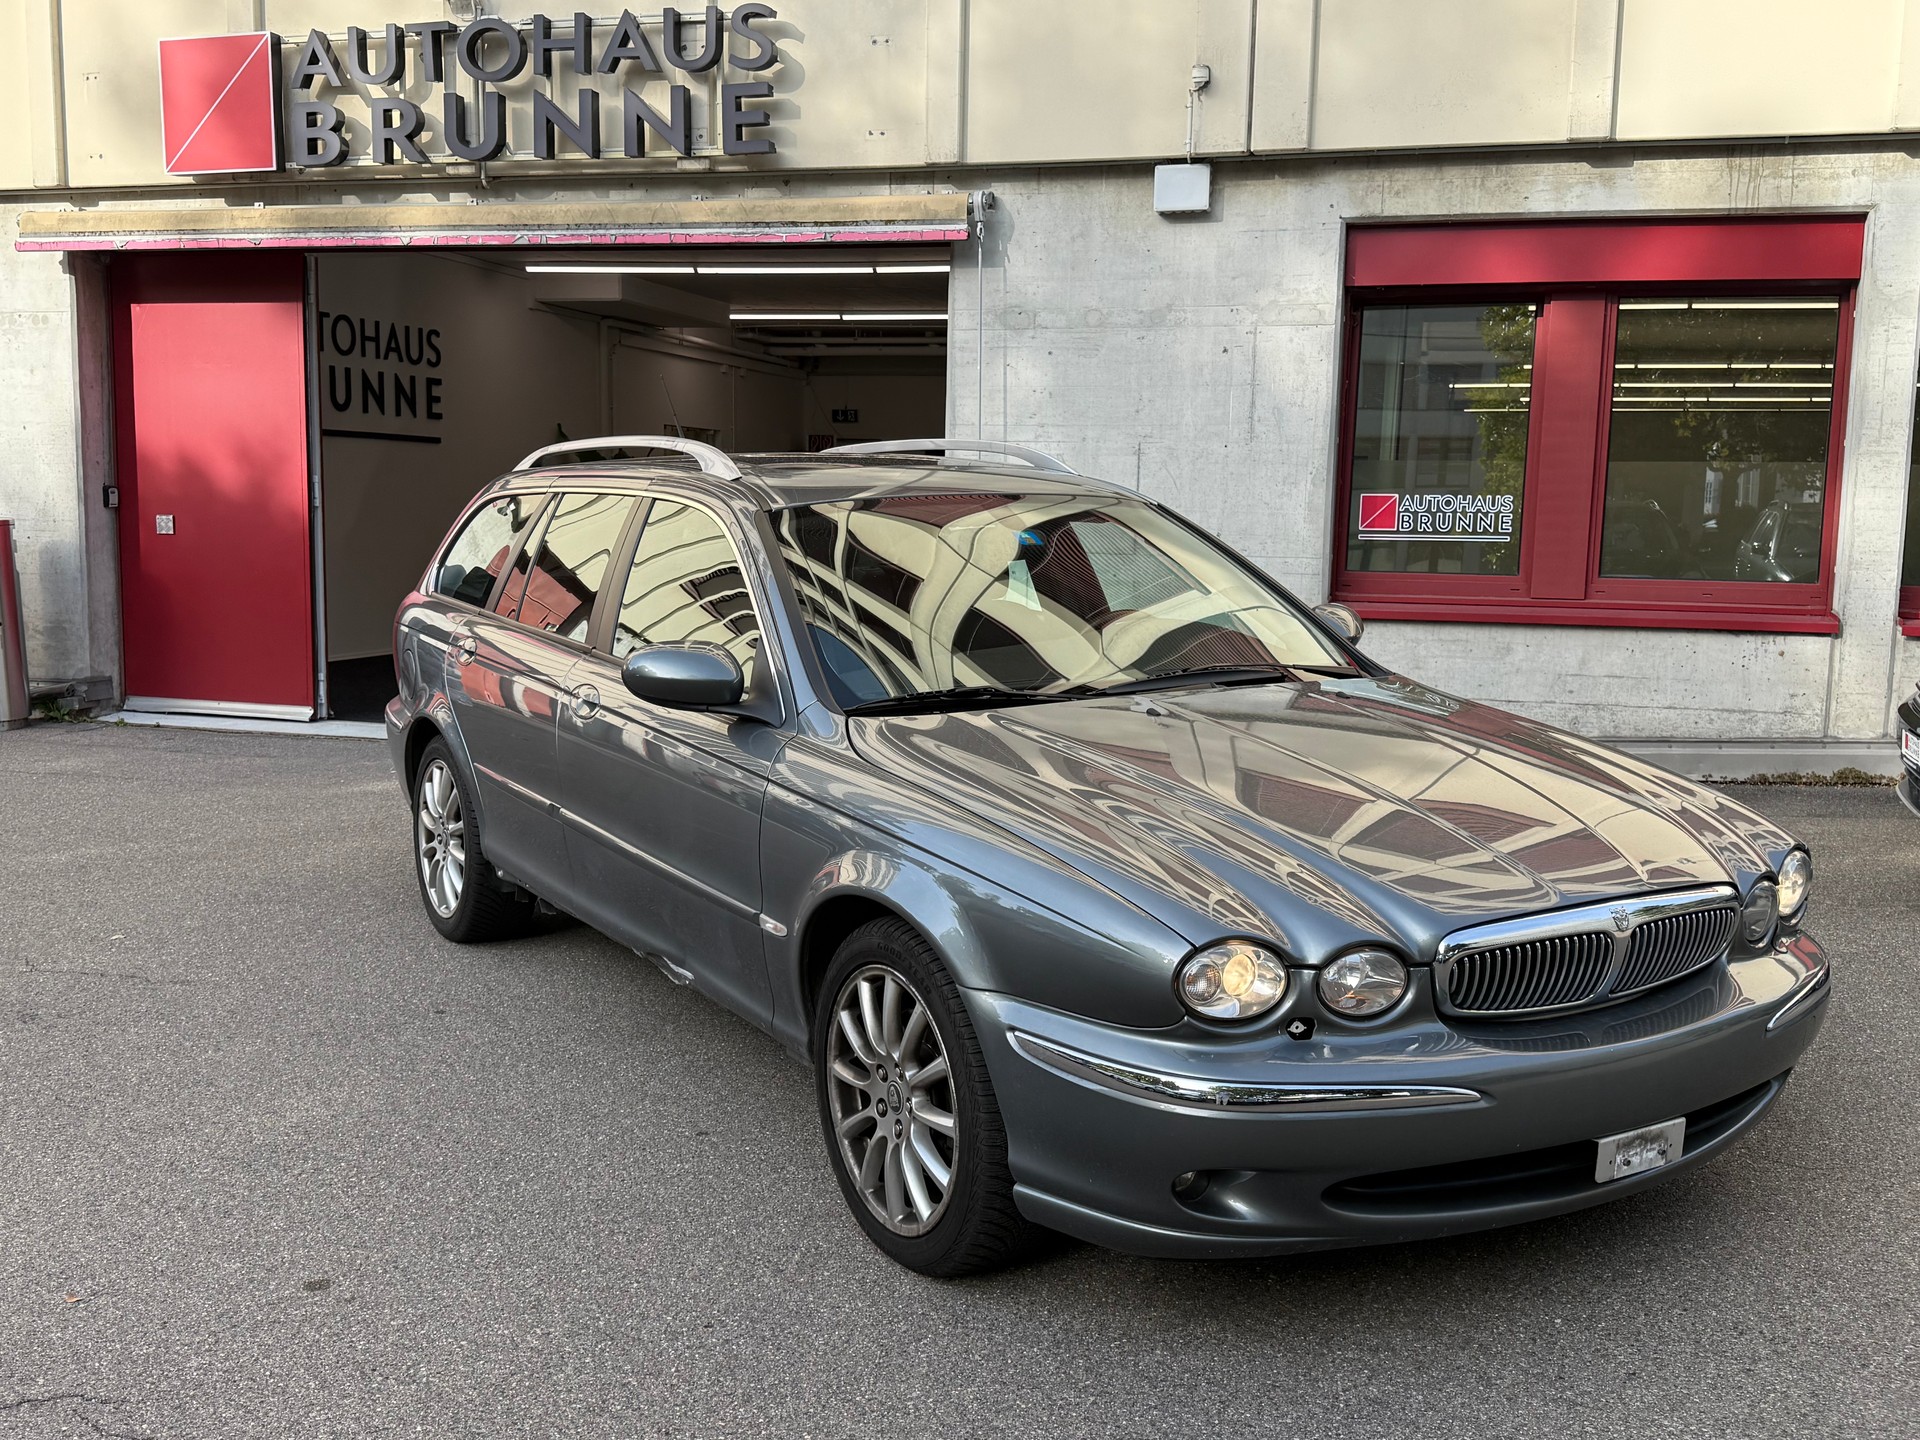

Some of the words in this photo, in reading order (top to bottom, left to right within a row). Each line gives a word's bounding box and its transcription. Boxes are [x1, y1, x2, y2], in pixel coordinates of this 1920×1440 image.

[292, 2, 779, 89] AUTOHAUS
[296, 83, 777, 167] BRUNNE
[329, 365, 443, 420] UNNE
[1399, 494, 1514, 513] AUTOHAUS
[1399, 513, 1513, 532] BRUNNE
